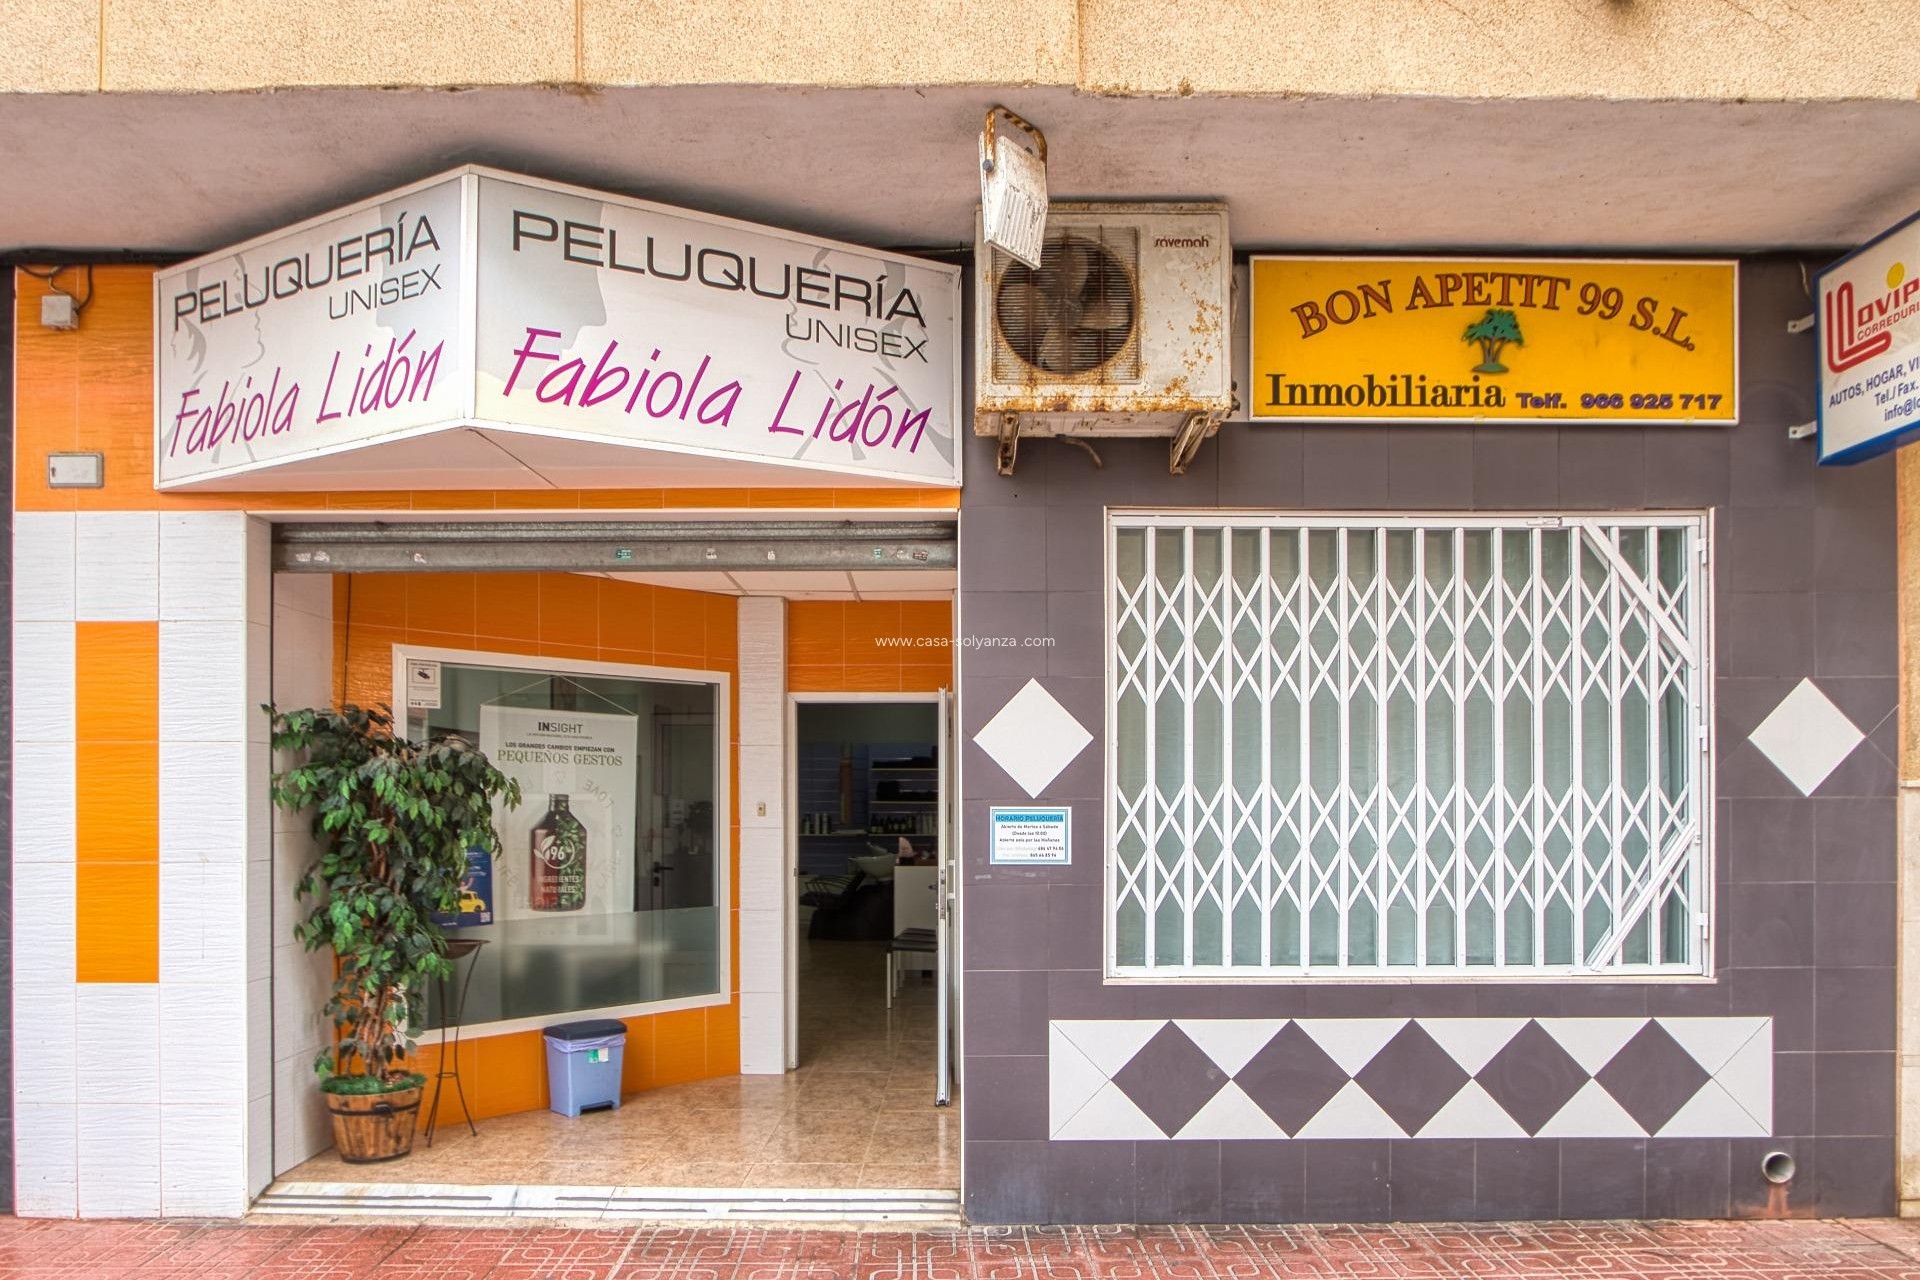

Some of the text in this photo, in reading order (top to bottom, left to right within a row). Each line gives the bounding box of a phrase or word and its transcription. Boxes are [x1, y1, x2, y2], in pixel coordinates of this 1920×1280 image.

[174, 211, 441, 332] PELUQUERÍA
[329, 263, 442, 320] UNISEX
[512, 209, 928, 328] PELUQUERÍA
[785, 313, 928, 363] UNISEX
[1290, 271, 1696, 352] BON APETIT 99 S.L.
[169, 328, 445, 457] Fabiola Lidón
[502, 326, 933, 453] Fabiola Lidón
[1265, 373, 1723, 410] Inmobiliaria Telf. 966 925 717
[1828, 354, 1920, 408] AUTOS, HOGAR, VI
[538, 721, 584, 734] INSIGHT
[497, 749, 623, 766] PEQUEÑOS GESTOS
